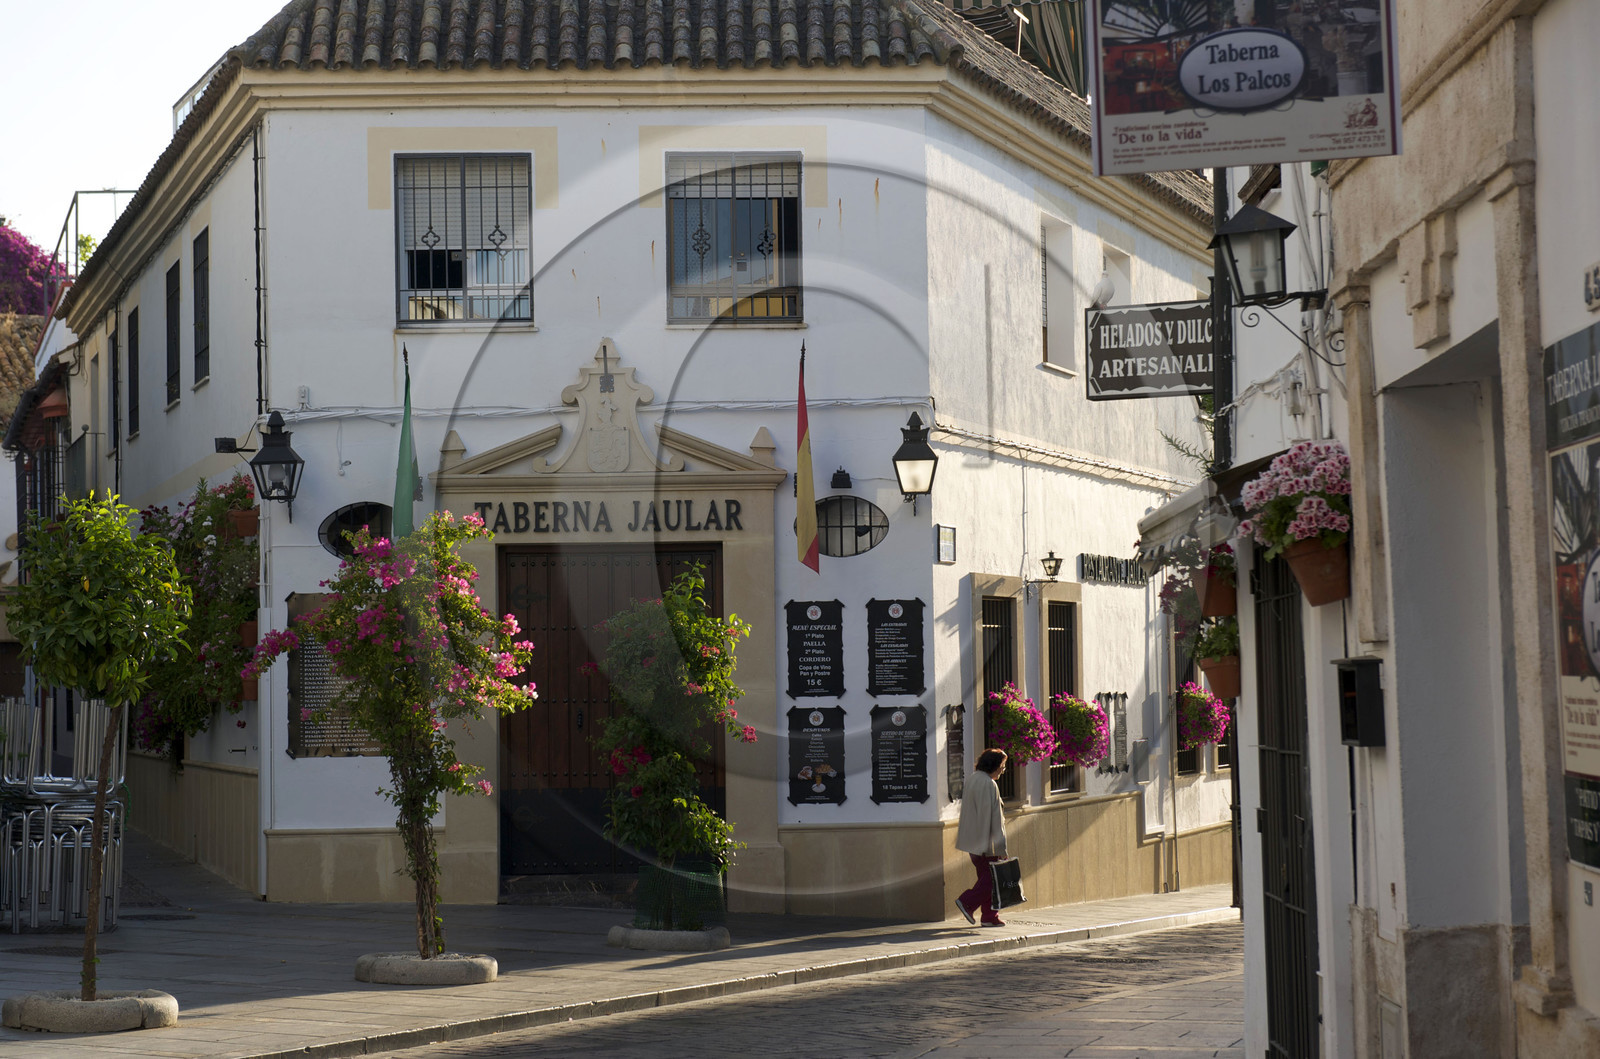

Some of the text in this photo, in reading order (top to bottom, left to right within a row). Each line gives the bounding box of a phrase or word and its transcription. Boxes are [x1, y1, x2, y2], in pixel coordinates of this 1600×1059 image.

[1205, 42, 1280, 65] Taberna
[1198, 69, 1291, 95] Los Palcos
[1141, 133, 1154, 143] to
[1158, 130, 1170, 142] la
[1100, 317, 1213, 349] HELADOS Y DULC
[1546, 358, 1592, 406] TABERNA
[474, 499, 743, 533] TABERNA JAULAR
